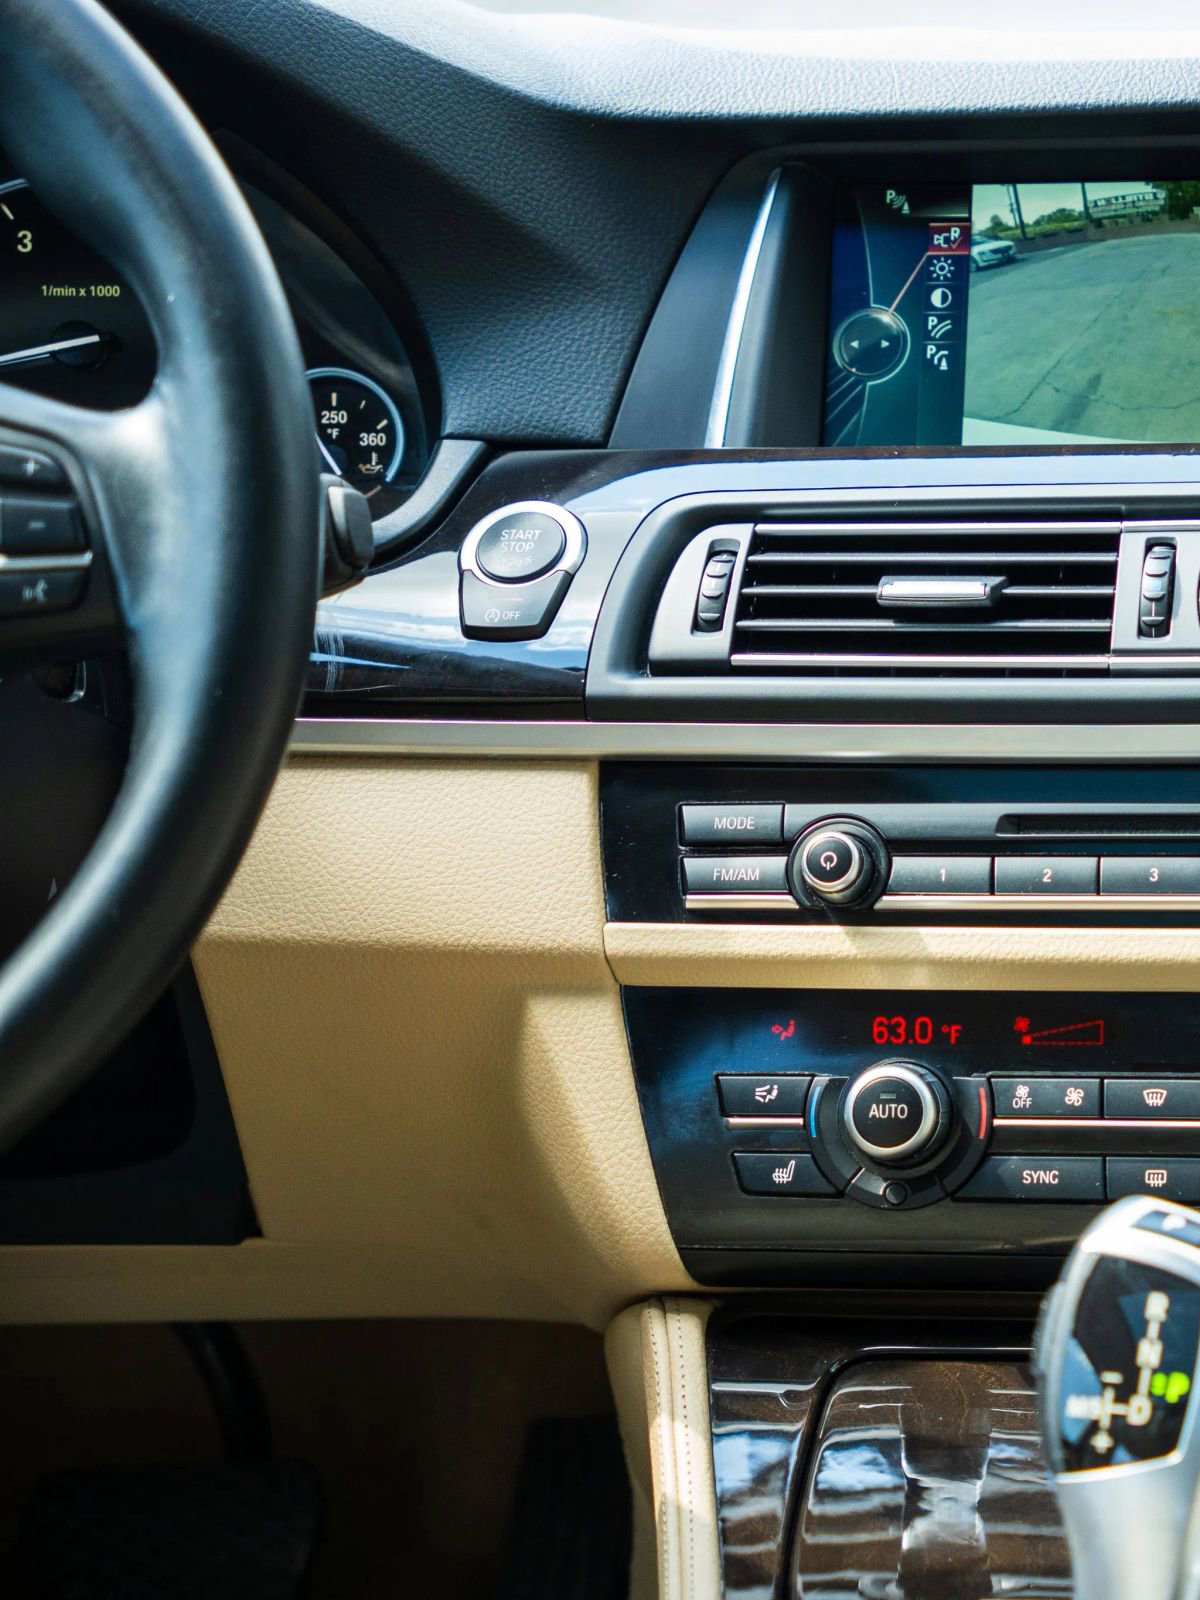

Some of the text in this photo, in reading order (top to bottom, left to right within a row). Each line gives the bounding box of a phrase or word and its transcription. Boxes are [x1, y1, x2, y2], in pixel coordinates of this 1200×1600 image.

[17, 230, 33, 252] 3
[41, 285, 120, 297] 1/min x 1000
[321, 410, 348, 424] 250
[359, 433, 386, 446] 360
[500, 529, 542, 541] START
[500, 541, 535, 553] STOP
[502, 611, 521, 620] OFF
[713, 816, 755, 830] MODE
[713, 868, 760, 881] FM/AM
[939, 868, 946, 882] 1
[1042, 868, 1052, 882] 2
[1149, 868, 1159, 882] 3
[872, 1016, 933, 1045] 63.0
[1012, 1098, 1033, 1109] OFF
[868, 1104, 908, 1119] AUTO
[1022, 1170, 1059, 1184] SYNC
